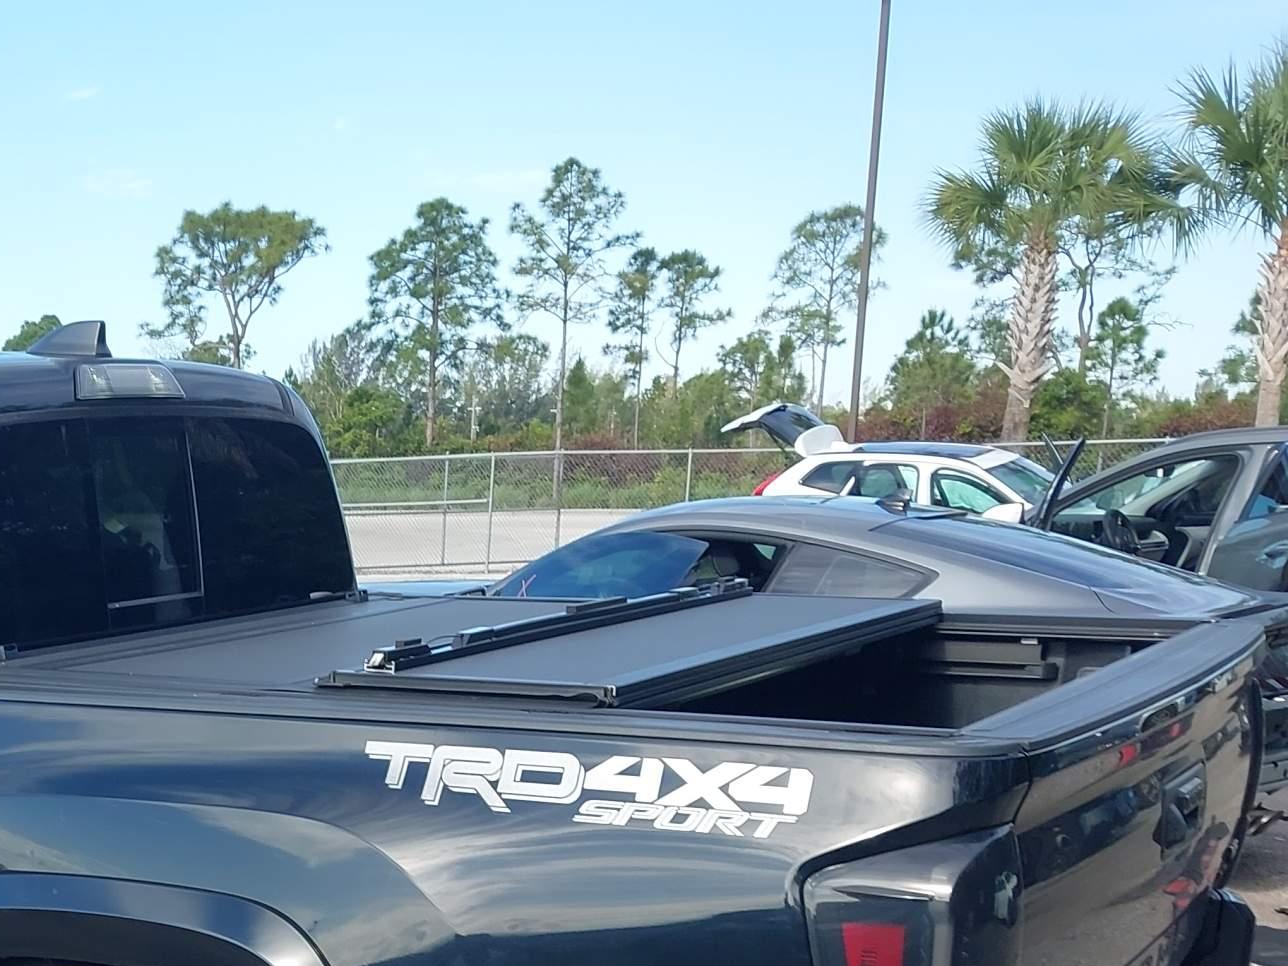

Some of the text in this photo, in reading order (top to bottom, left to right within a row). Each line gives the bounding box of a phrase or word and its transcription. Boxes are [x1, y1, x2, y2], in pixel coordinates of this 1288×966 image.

[365, 740, 814, 815] TRD 4X4
[572, 800, 798, 838] SPORT
